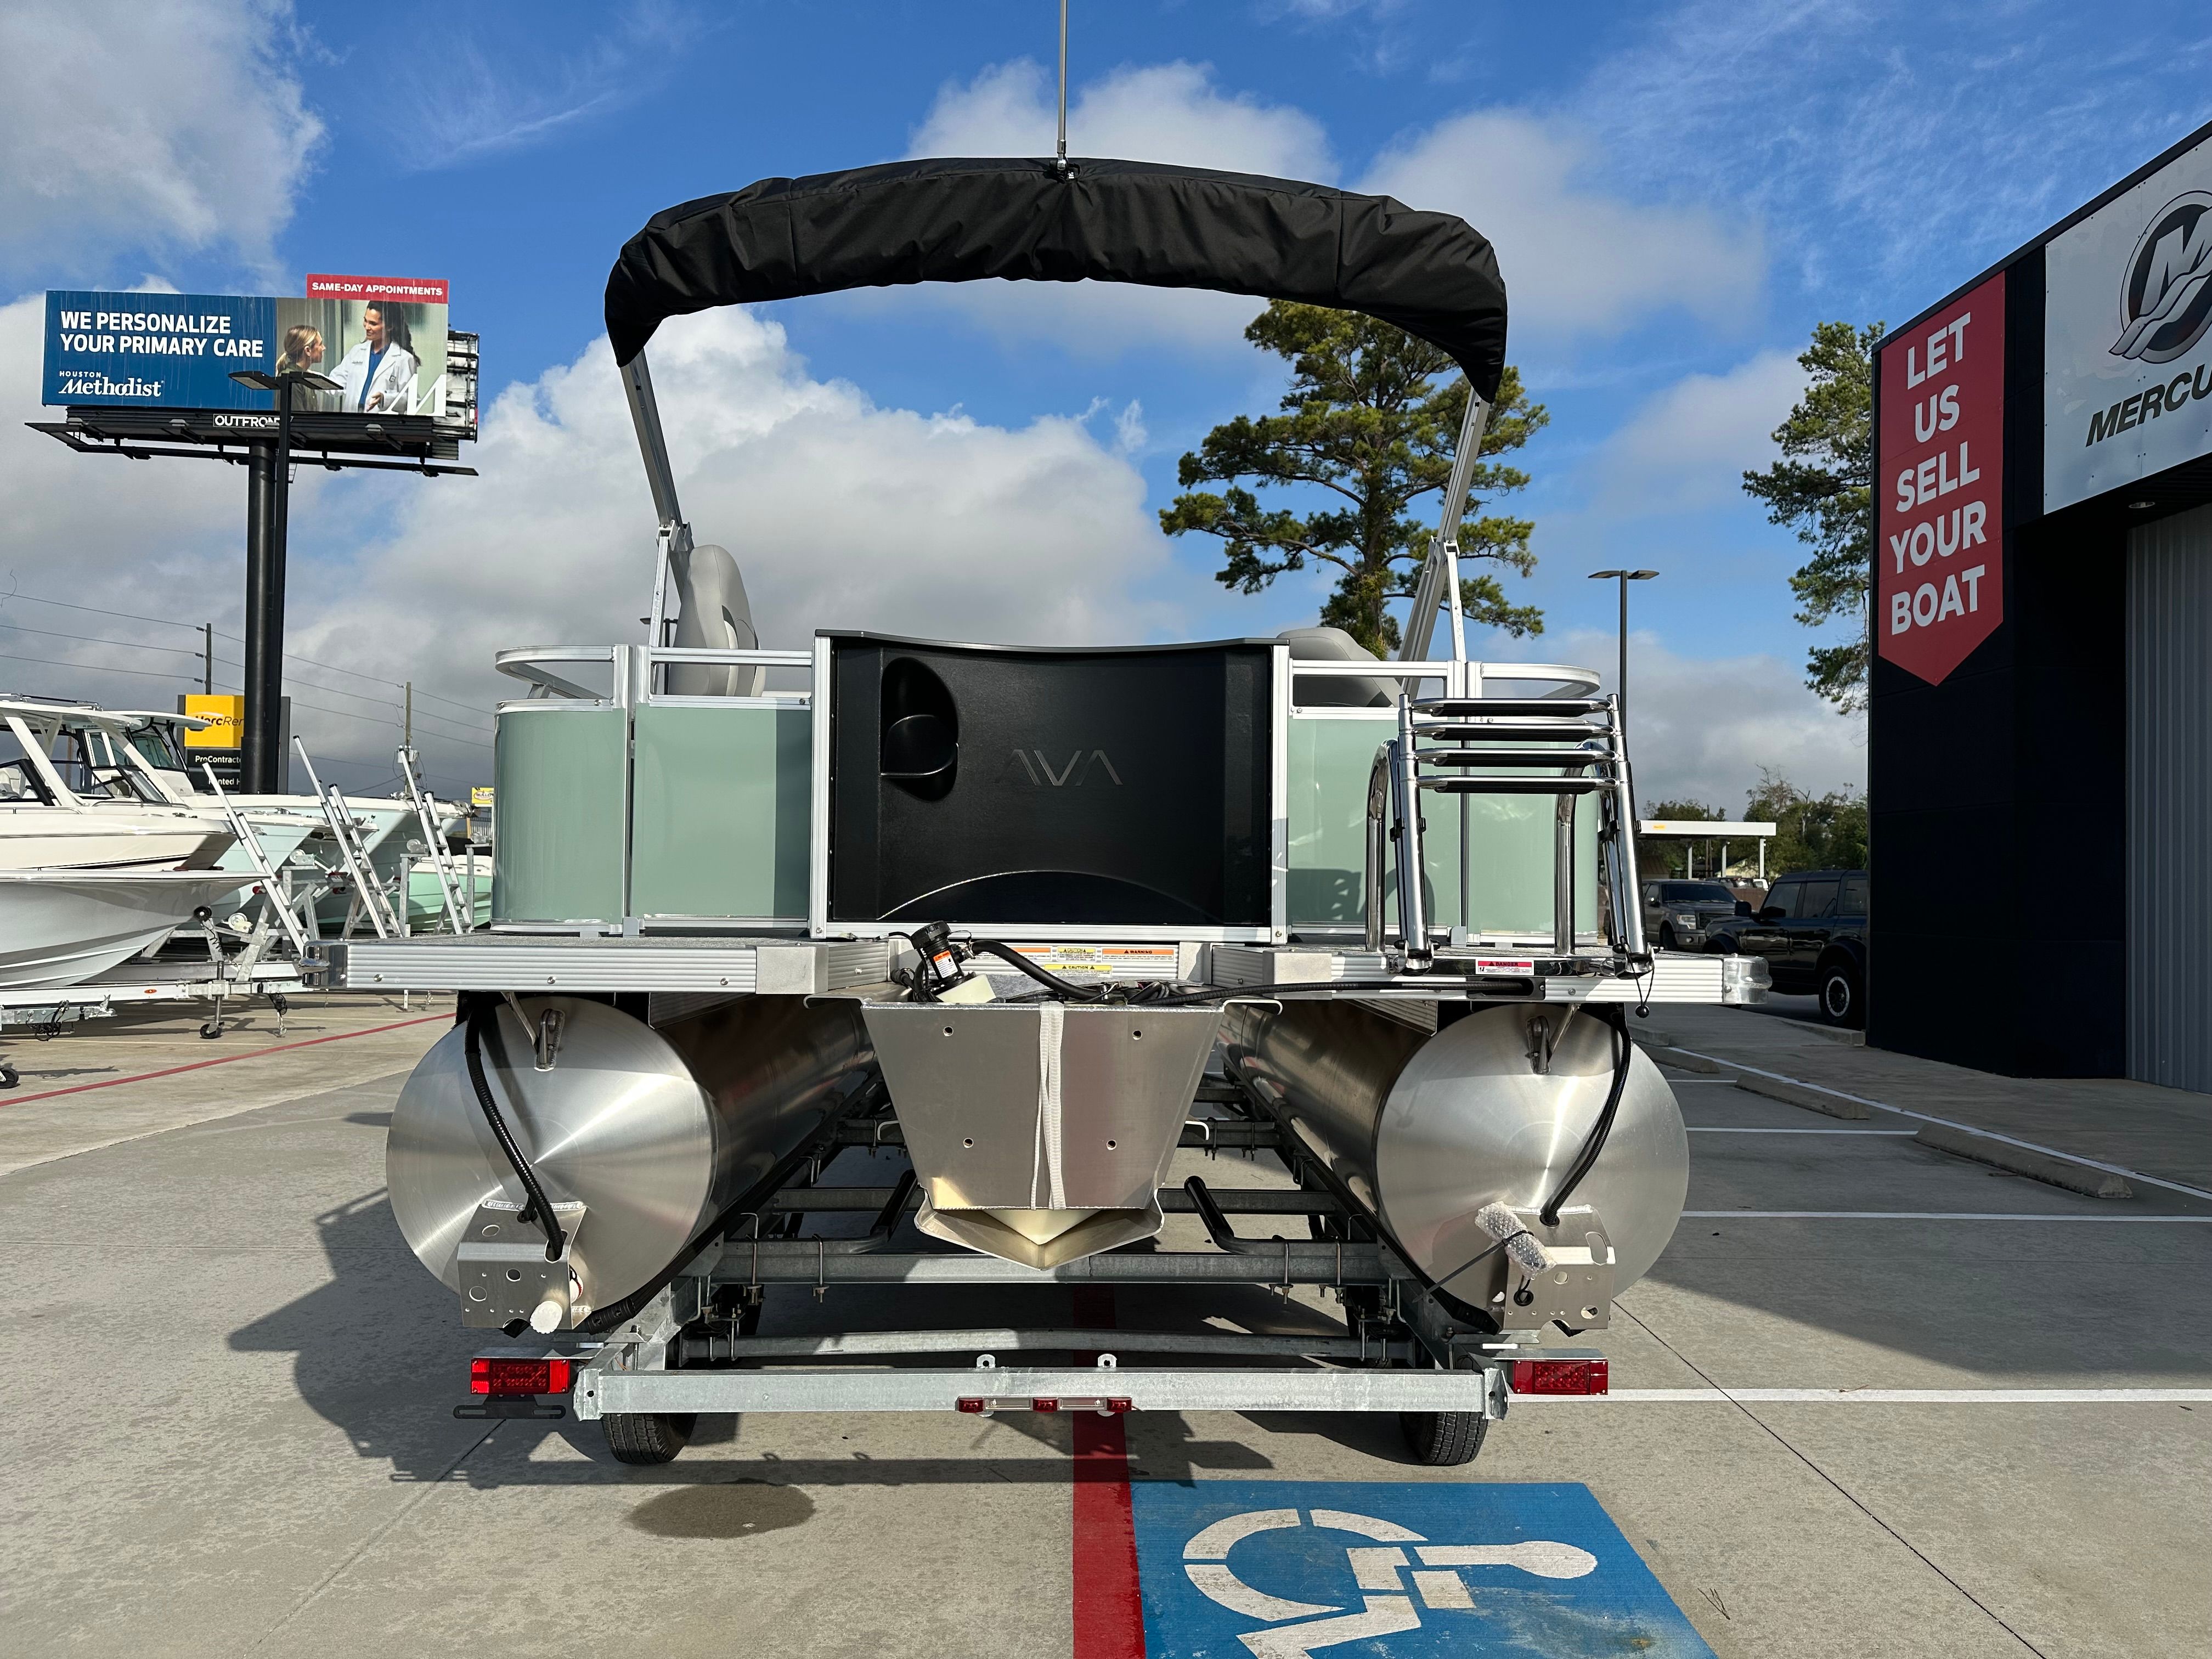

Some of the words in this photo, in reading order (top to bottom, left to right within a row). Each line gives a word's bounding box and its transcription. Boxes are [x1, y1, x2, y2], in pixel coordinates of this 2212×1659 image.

[312, 282, 364, 292] SAME-DAY
[365, 285, 443, 296] APPOINTMENTS
[60, 311, 92, 329] WE
[97, 312, 231, 334] PERSONALIZE
[60, 334, 115, 352] YOUR
[120, 336, 208, 356] PRIMARY
[213, 338, 263, 357] CARE
[1908, 312, 1971, 390] LET
[58, 377, 161, 397] Methodist
[1915, 384, 1960, 443] US
[2085, 363, 2212, 447] MERCU
[1896, 441, 1980, 512] SELL
[1889, 500, 1987, 574] YOUR
[1892, 564, 1985, 635] BOAT
